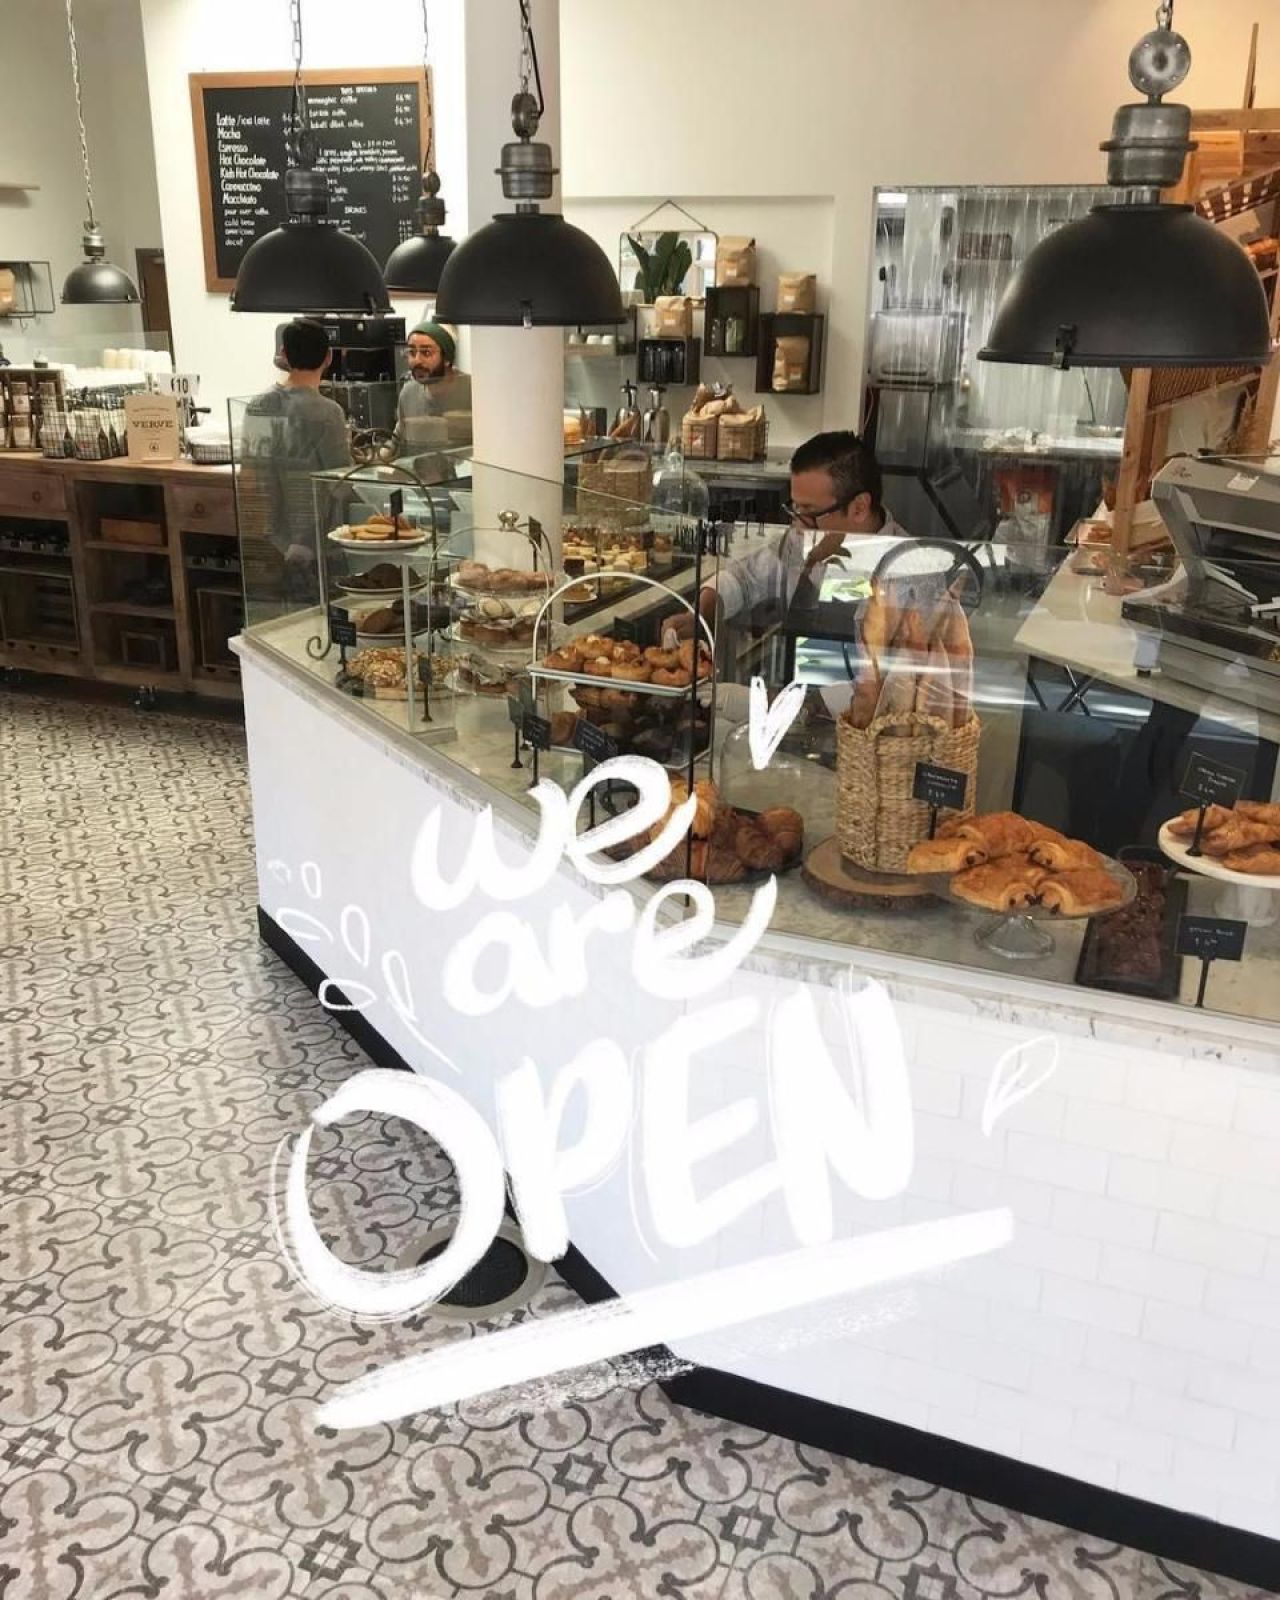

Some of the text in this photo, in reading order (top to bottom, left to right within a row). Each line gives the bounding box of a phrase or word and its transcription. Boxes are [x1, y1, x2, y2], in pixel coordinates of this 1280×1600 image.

[217, 127, 241, 139] Mocha
[218, 140, 249, 152] Espresso
[219, 153, 267, 166] Hot Chocolate
[248, 167, 279, 179] Chocolate
[221, 179, 262, 192] Cappuccino
[222, 192, 257, 204] Macchiato
[132, 420, 175, 429] VERVE
